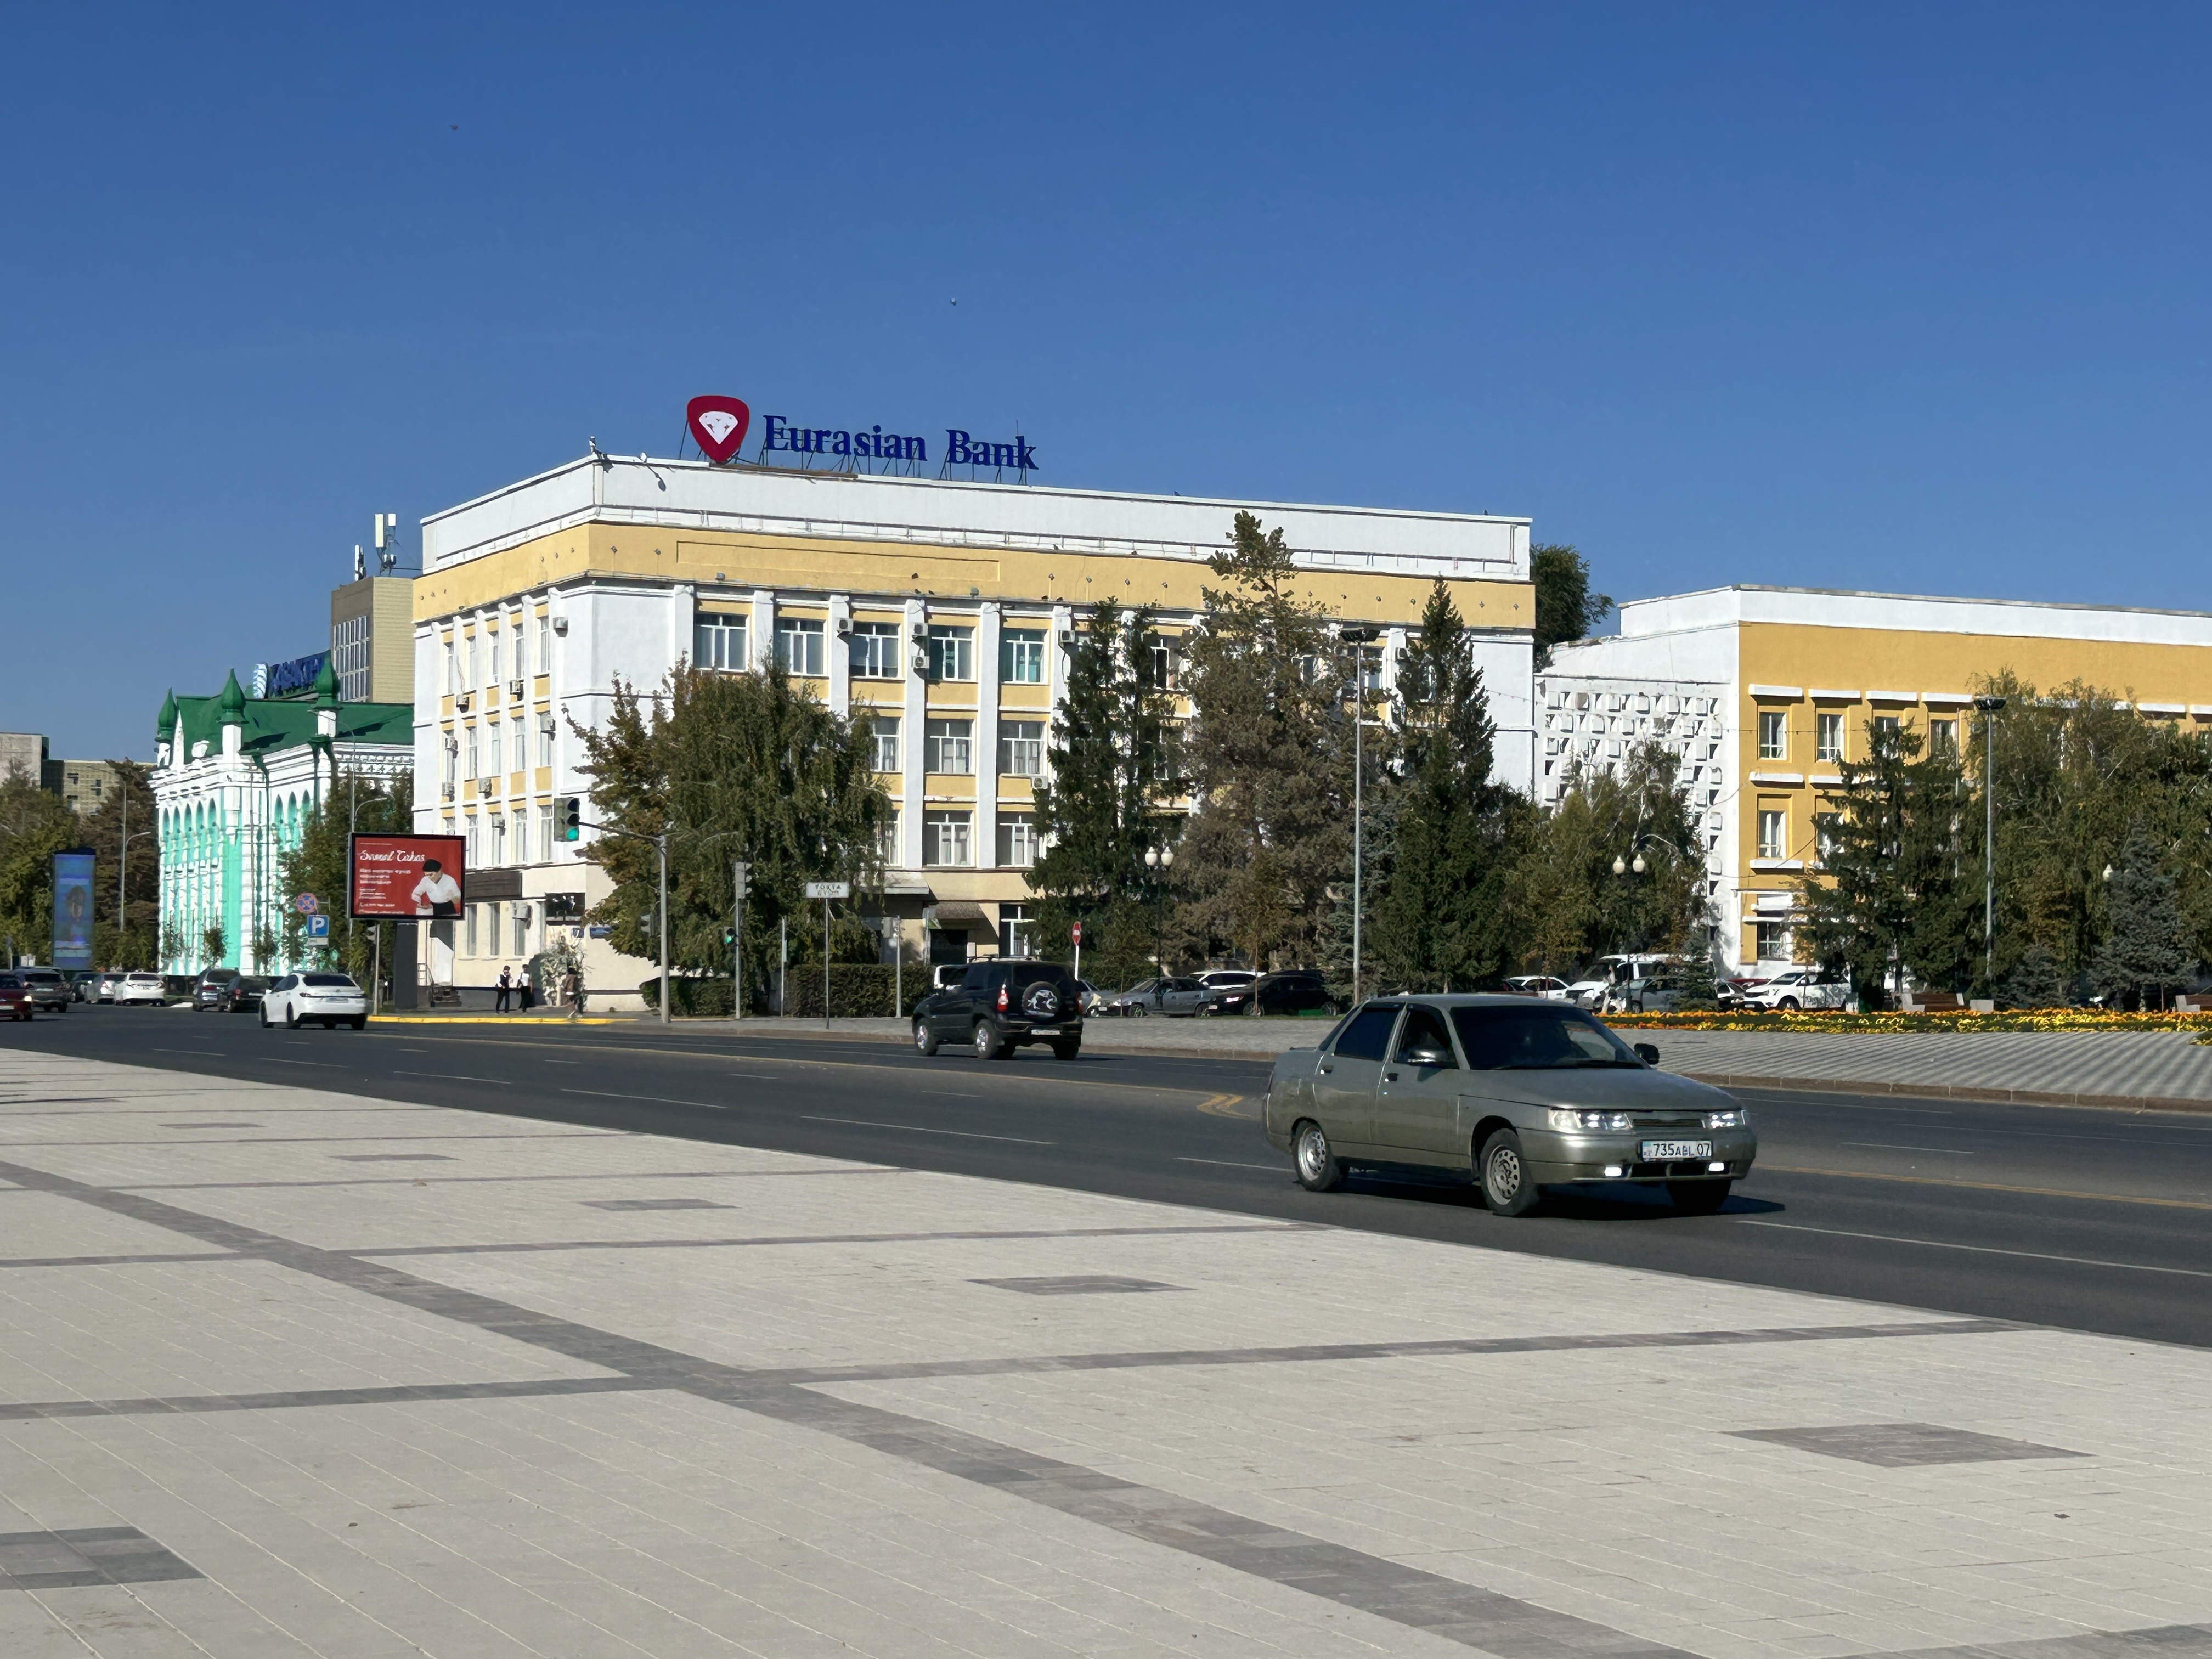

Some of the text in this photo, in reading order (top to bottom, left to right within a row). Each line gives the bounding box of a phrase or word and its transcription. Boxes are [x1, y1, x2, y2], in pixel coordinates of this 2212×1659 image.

[763, 415, 1039, 470] Eurasian Bank
[397, 850, 425, 862] Cakes
[312, 917, 325, 934] P
[1697, 1143, 1710, 1156] 07
